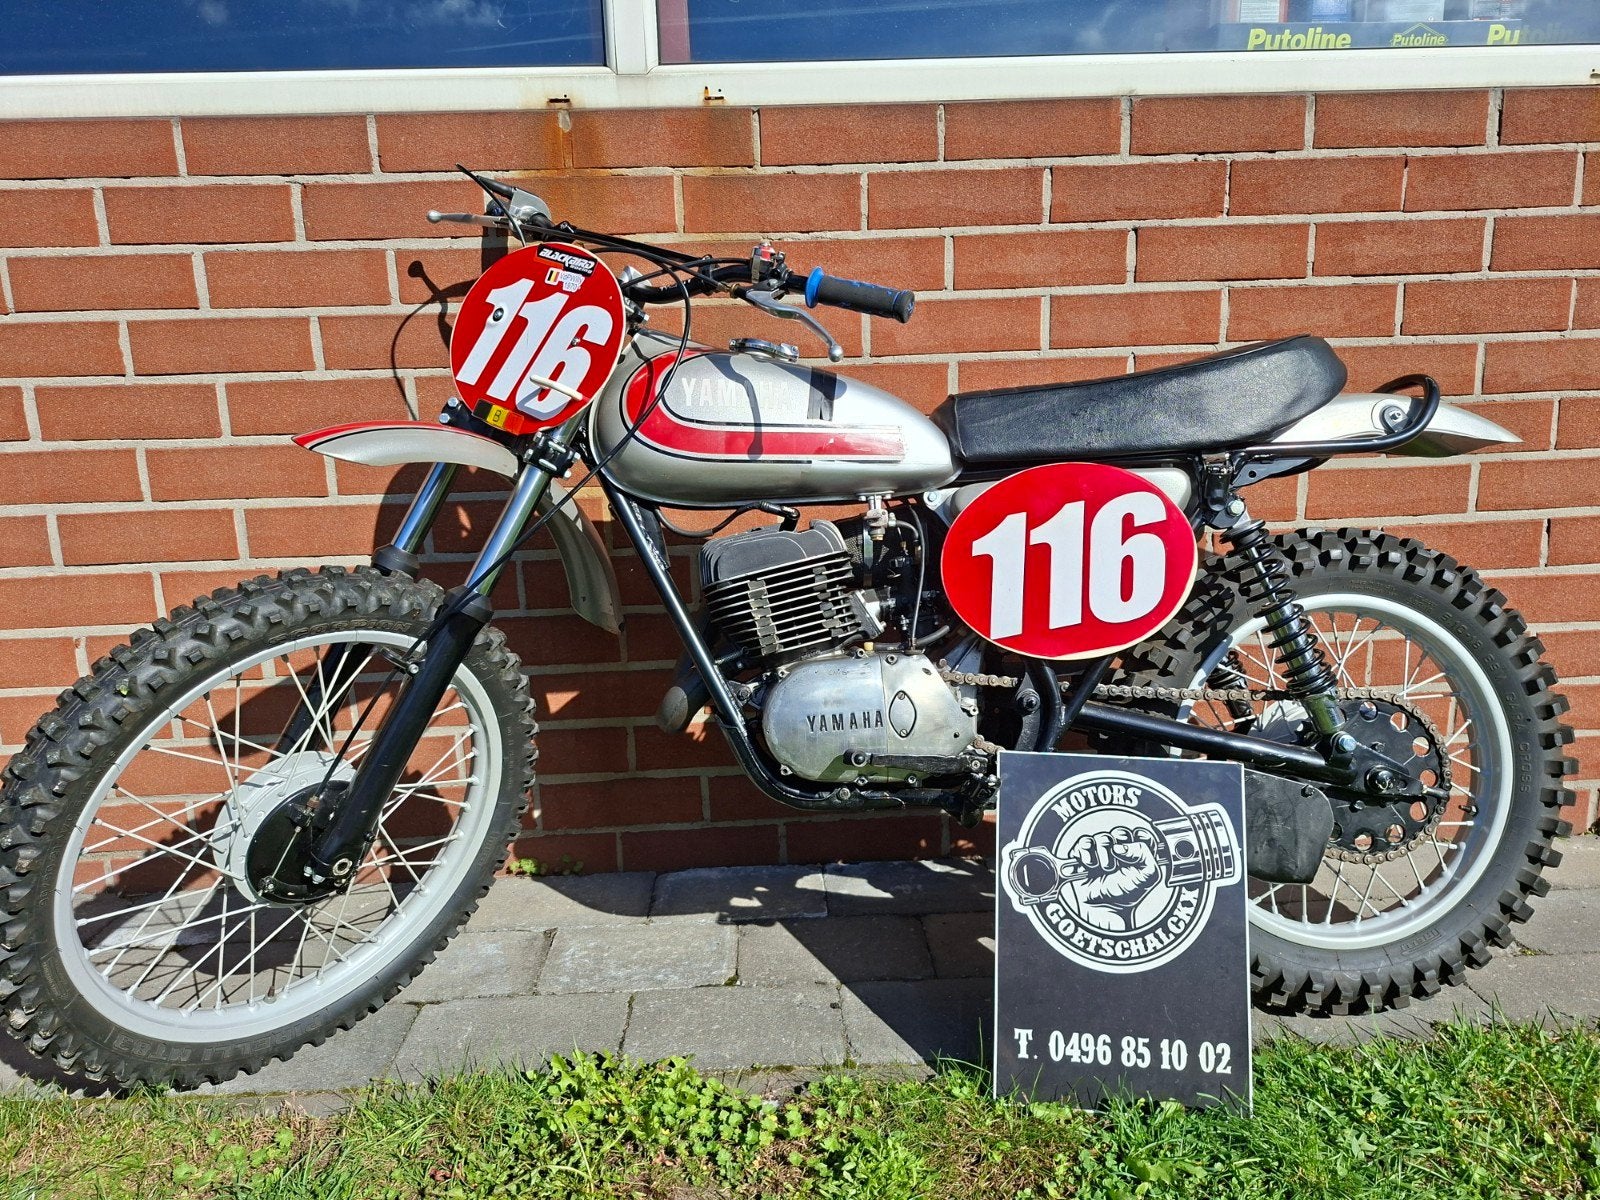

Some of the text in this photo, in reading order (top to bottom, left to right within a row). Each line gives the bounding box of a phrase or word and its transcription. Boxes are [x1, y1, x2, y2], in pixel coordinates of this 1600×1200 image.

[1247, 28, 1352, 50] Putoline
[1392, 33, 1446, 47] Putoline
[456, 278, 613, 420] 116
[681, 377, 791, 409] YAMHA
[971, 491, 1167, 640] 116
[806, 709, 884, 733] YAMAHA
[1051, 784, 1142, 823] MOTORS
[1045, 887, 1200, 959] GOETSCHALCKX
[1013, 1027, 1232, 1075] T. 0496 85 10 02
